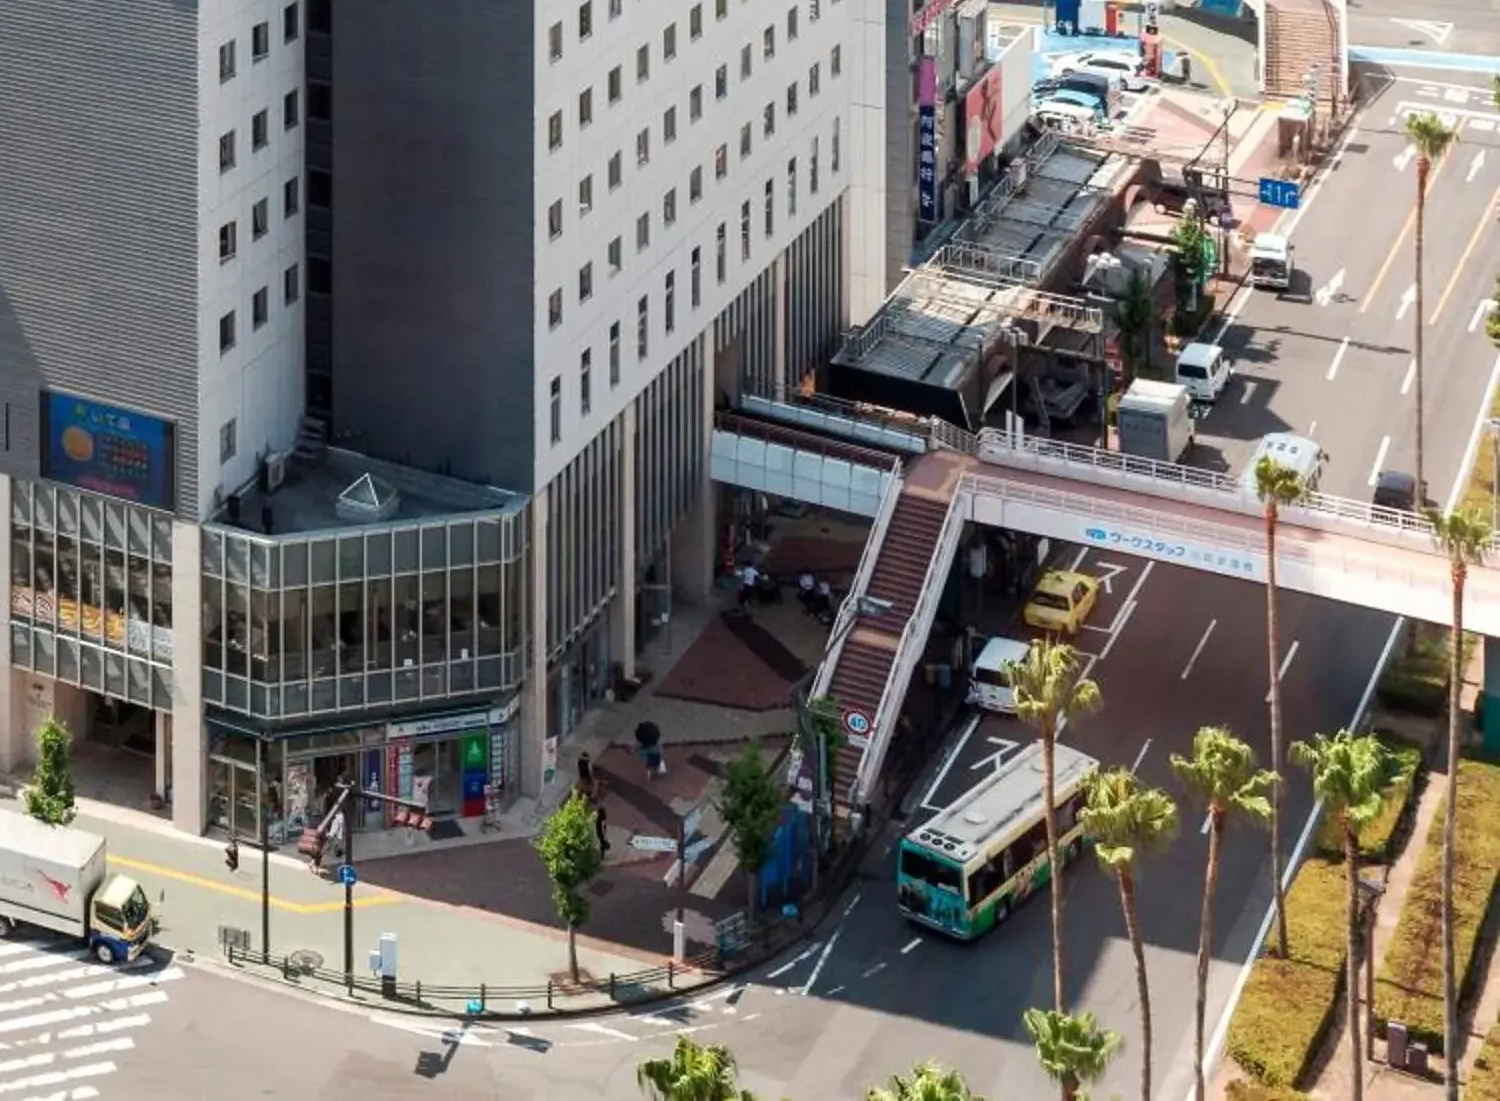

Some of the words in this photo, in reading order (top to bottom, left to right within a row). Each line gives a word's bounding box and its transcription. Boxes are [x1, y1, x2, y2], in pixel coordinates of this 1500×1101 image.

[1109, 531, 1185, 557] ワークスタッフ
[850, 716, 867, 730] 40
